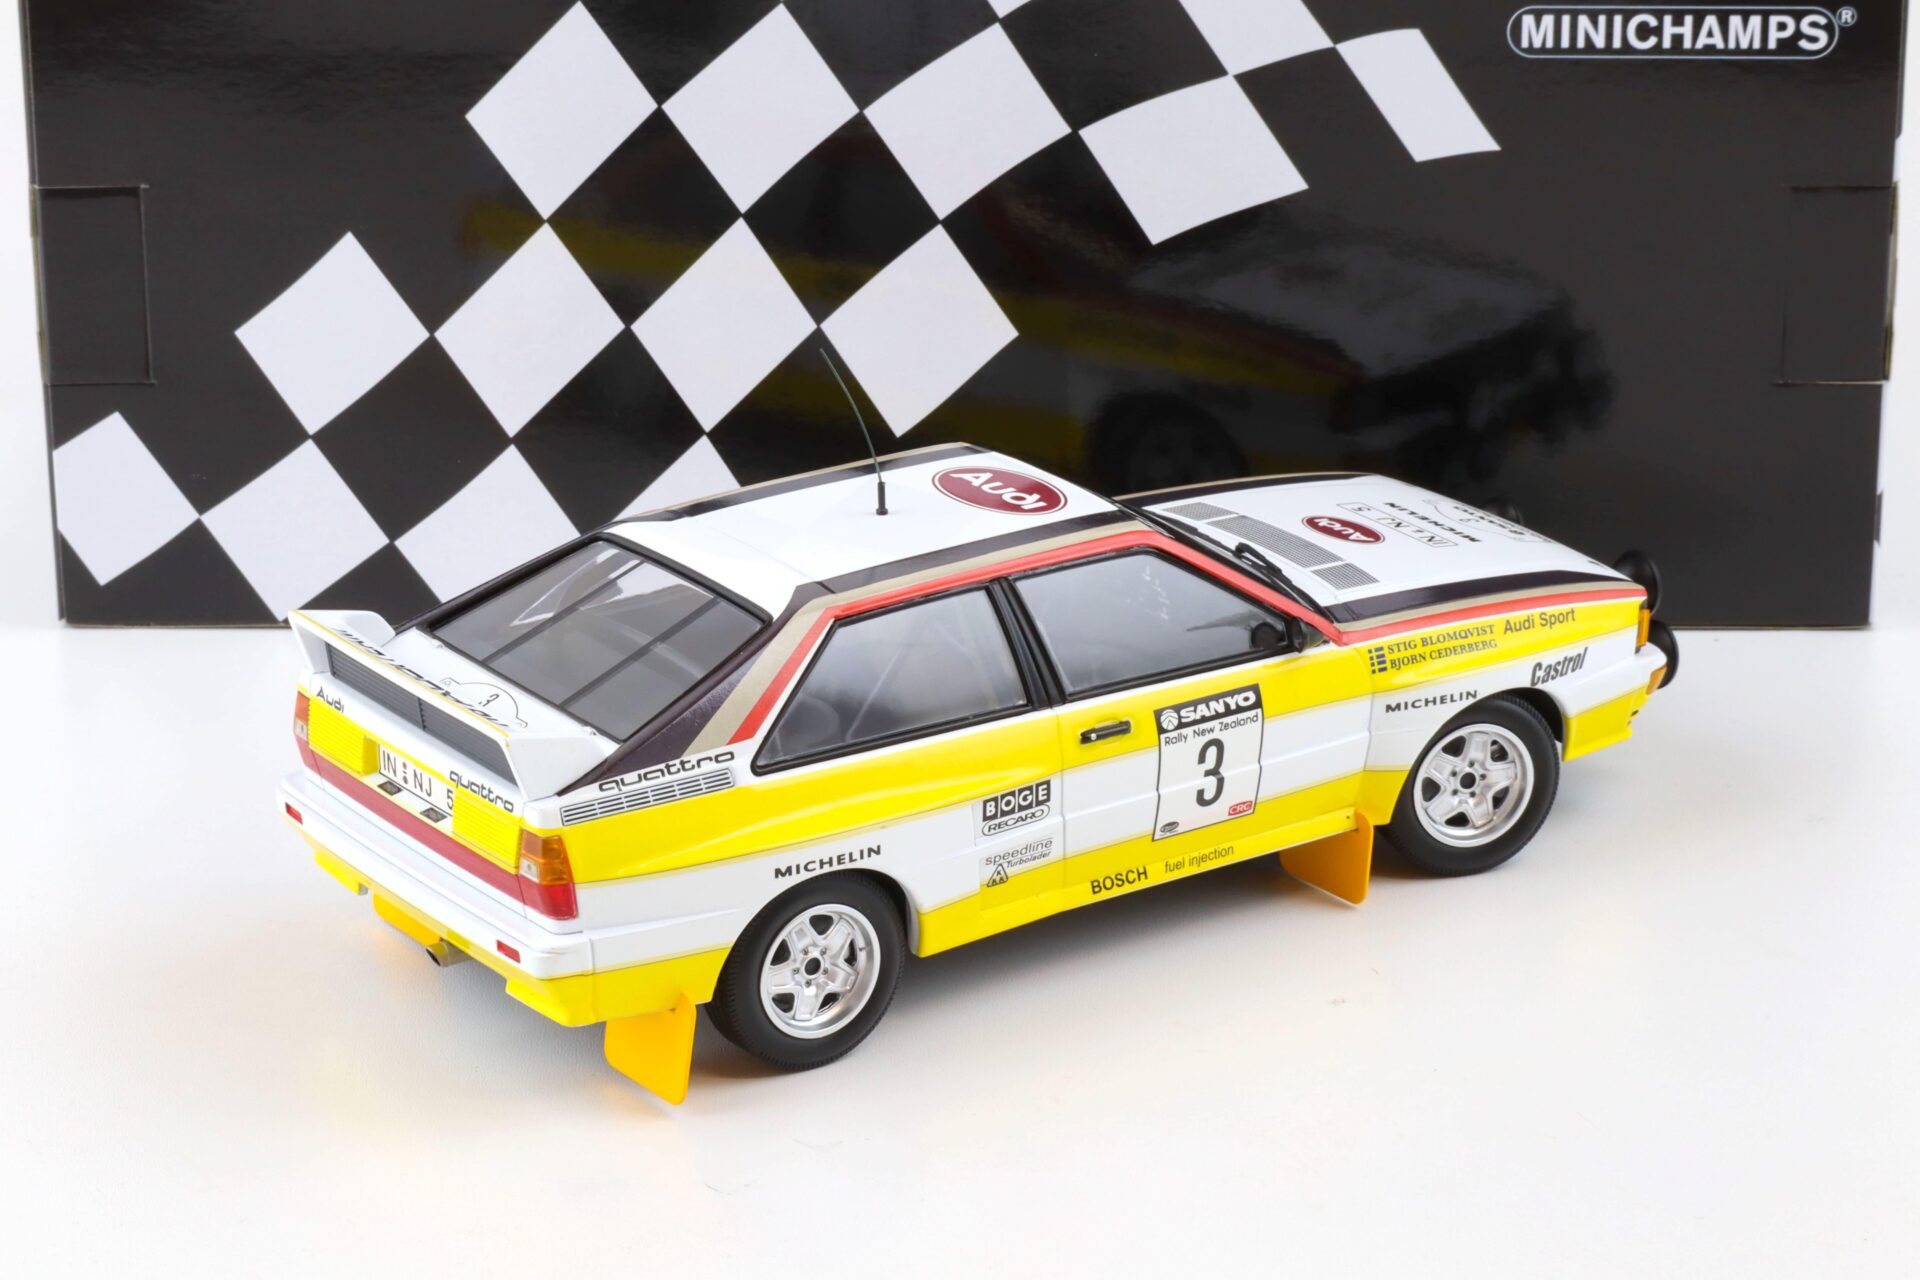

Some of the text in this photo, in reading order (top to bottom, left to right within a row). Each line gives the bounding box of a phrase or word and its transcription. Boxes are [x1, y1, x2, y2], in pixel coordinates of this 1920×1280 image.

[1520, 14, 1829, 50] MINICHAMPS
[950, 472, 1048, 510] Audi
[1313, 518, 1375, 543] Audi
[1384, 502, 1483, 543] MICHELIN
[1504, 608, 1576, 635] Audi Sport
[1388, 624, 1496, 655] STIG BLOMQVIST
[1390, 639, 1498, 671] BJORN CEDERBERG
[1531, 647, 1588, 687] Castrol
[316, 686, 345, 713] Audi
[1179, 691, 1256, 722] SANYO
[1385, 689, 1478, 713] MICHELIN
[1164, 713, 1259, 747] Rally New Zealand
[382, 750, 397, 777] IN
[413, 768, 432, 797] NJ
[599, 750, 735, 792] quattro
[1196, 738, 1225, 807] 3
[449, 770, 514, 813] quattro
[985, 783, 1048, 817] BOGE
[987, 809, 1045, 833] RECARO
[774, 844, 882, 879] MICHELIN
[985, 839, 1053, 866] speedline
[1006, 851, 1051, 868] Turbolader
[1165, 846, 1235, 873] fuel injection
[1090, 866, 1148, 894] BOSCH
